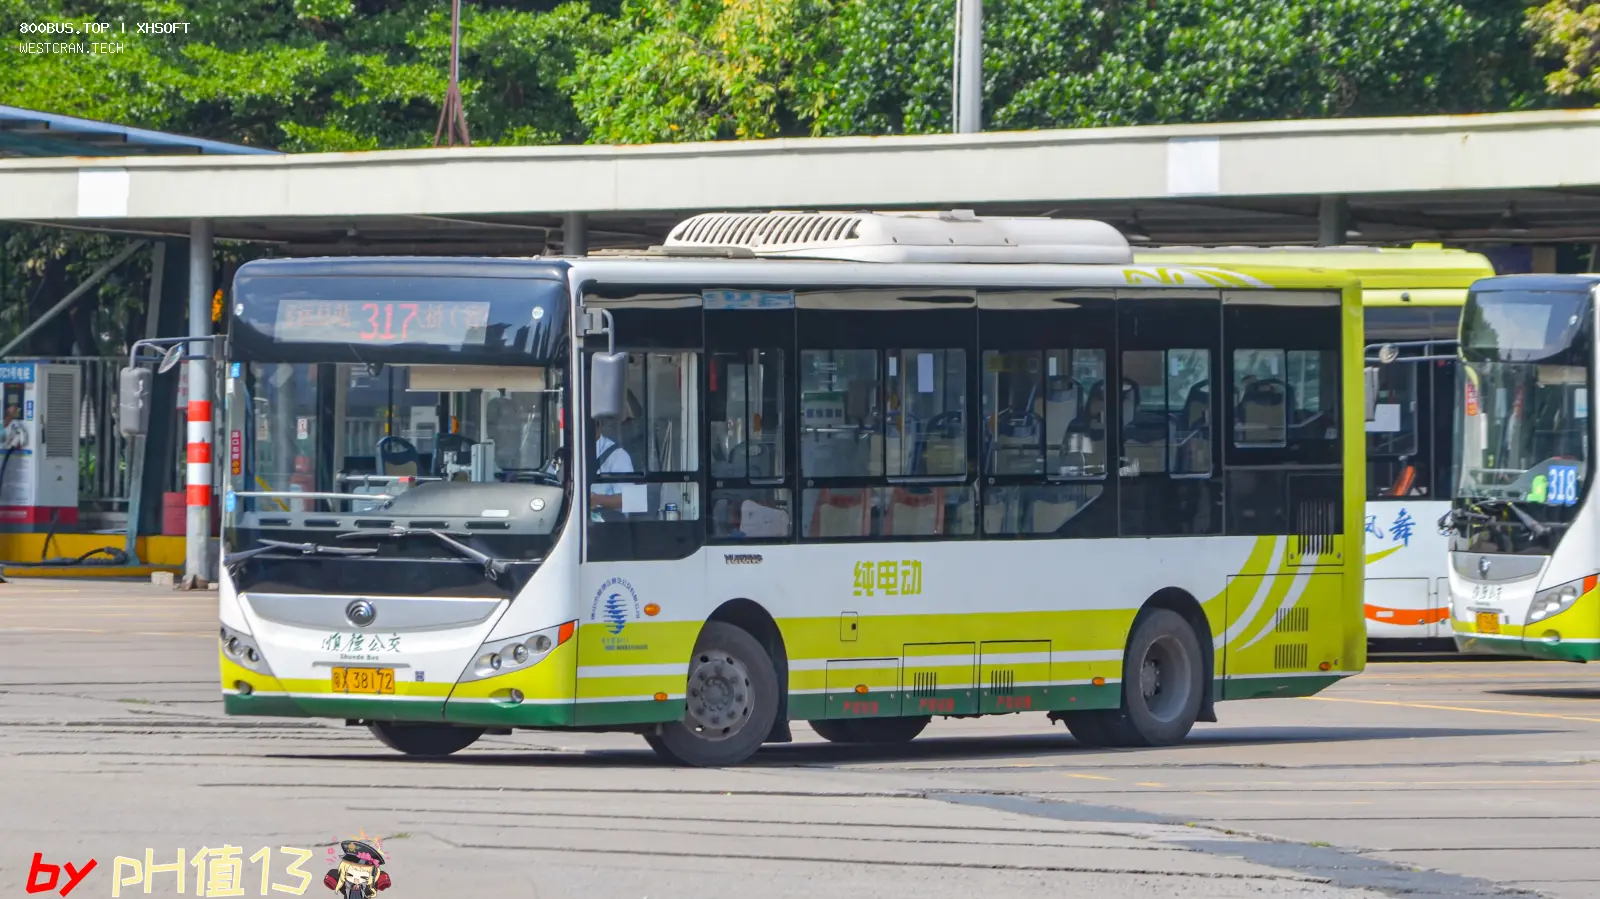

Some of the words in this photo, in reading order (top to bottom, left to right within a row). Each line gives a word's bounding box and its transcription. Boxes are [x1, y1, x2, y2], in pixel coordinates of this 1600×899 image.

[360, 303, 418, 340] 317
[1548, 468, 1576, 501] 318
[853, 560, 922, 597] 纯电动
